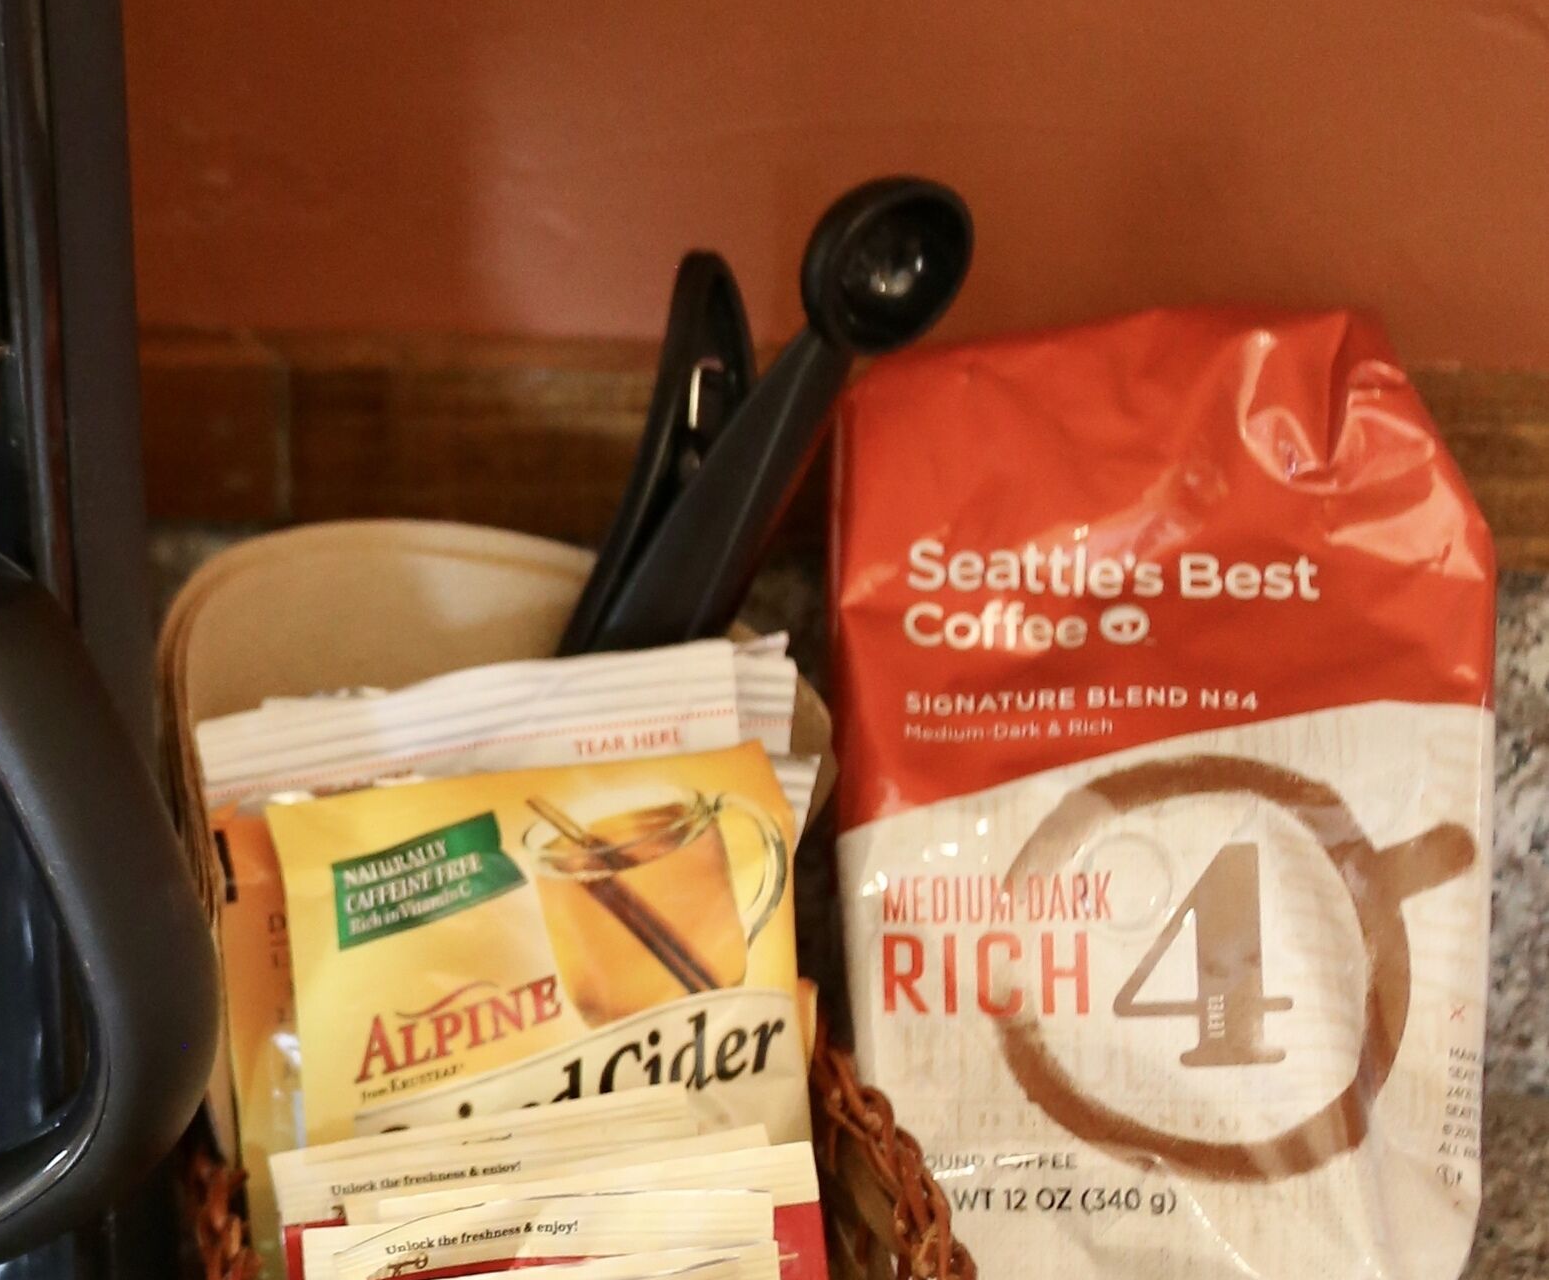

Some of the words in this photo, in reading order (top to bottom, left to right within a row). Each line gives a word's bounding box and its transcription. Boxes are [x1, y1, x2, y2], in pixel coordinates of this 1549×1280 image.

[907, 536, 1164, 599] Seattle's
[1179, 552, 1320, 602] Best
[903, 598, 1088, 650] Coffee
[905, 688, 1076, 716] SIGNATURE
[1086, 685, 1188, 710] BLEND
[573, 734, 625, 756] TEAR
[633, 726, 683, 750] HERE
[1068, 717, 1113, 736] Rich
[343, 839, 447, 888] NATURALLY
[345, 870, 433, 914] CAFFEINE
[434, 852, 482, 886] FREE
[349, 909, 382, 935] Rich
[883, 931, 1090, 1017] RICH
[1113, 843, 1294, 1067] 4
[354, 974, 562, 1084] ALPINE
[599, 1011, 785, 1093] Cider
[330, 1179, 377, 1197] Unlock
[380, 1175, 401, 1191] the
[403, 1167, 466, 1188] freshness
[469, 1166, 478, 1178] &
[925, 1152, 986, 1171] OUND
[954, 1187, 995, 1211] WT
[1003, 1188, 1027, 1211] 12
[1035, 1187, 1072, 1211] OZ
[1080, 1186, 1140, 1215] (340
[1150, 1186, 1177, 1215] g)
[385, 1238, 435, 1256] Unlock
[437, 1233, 460, 1248] the
[460, 1223, 521, 1245] freshness
[524, 1221, 533, 1233] &
[536, 1219, 579, 1237] enjoy!
